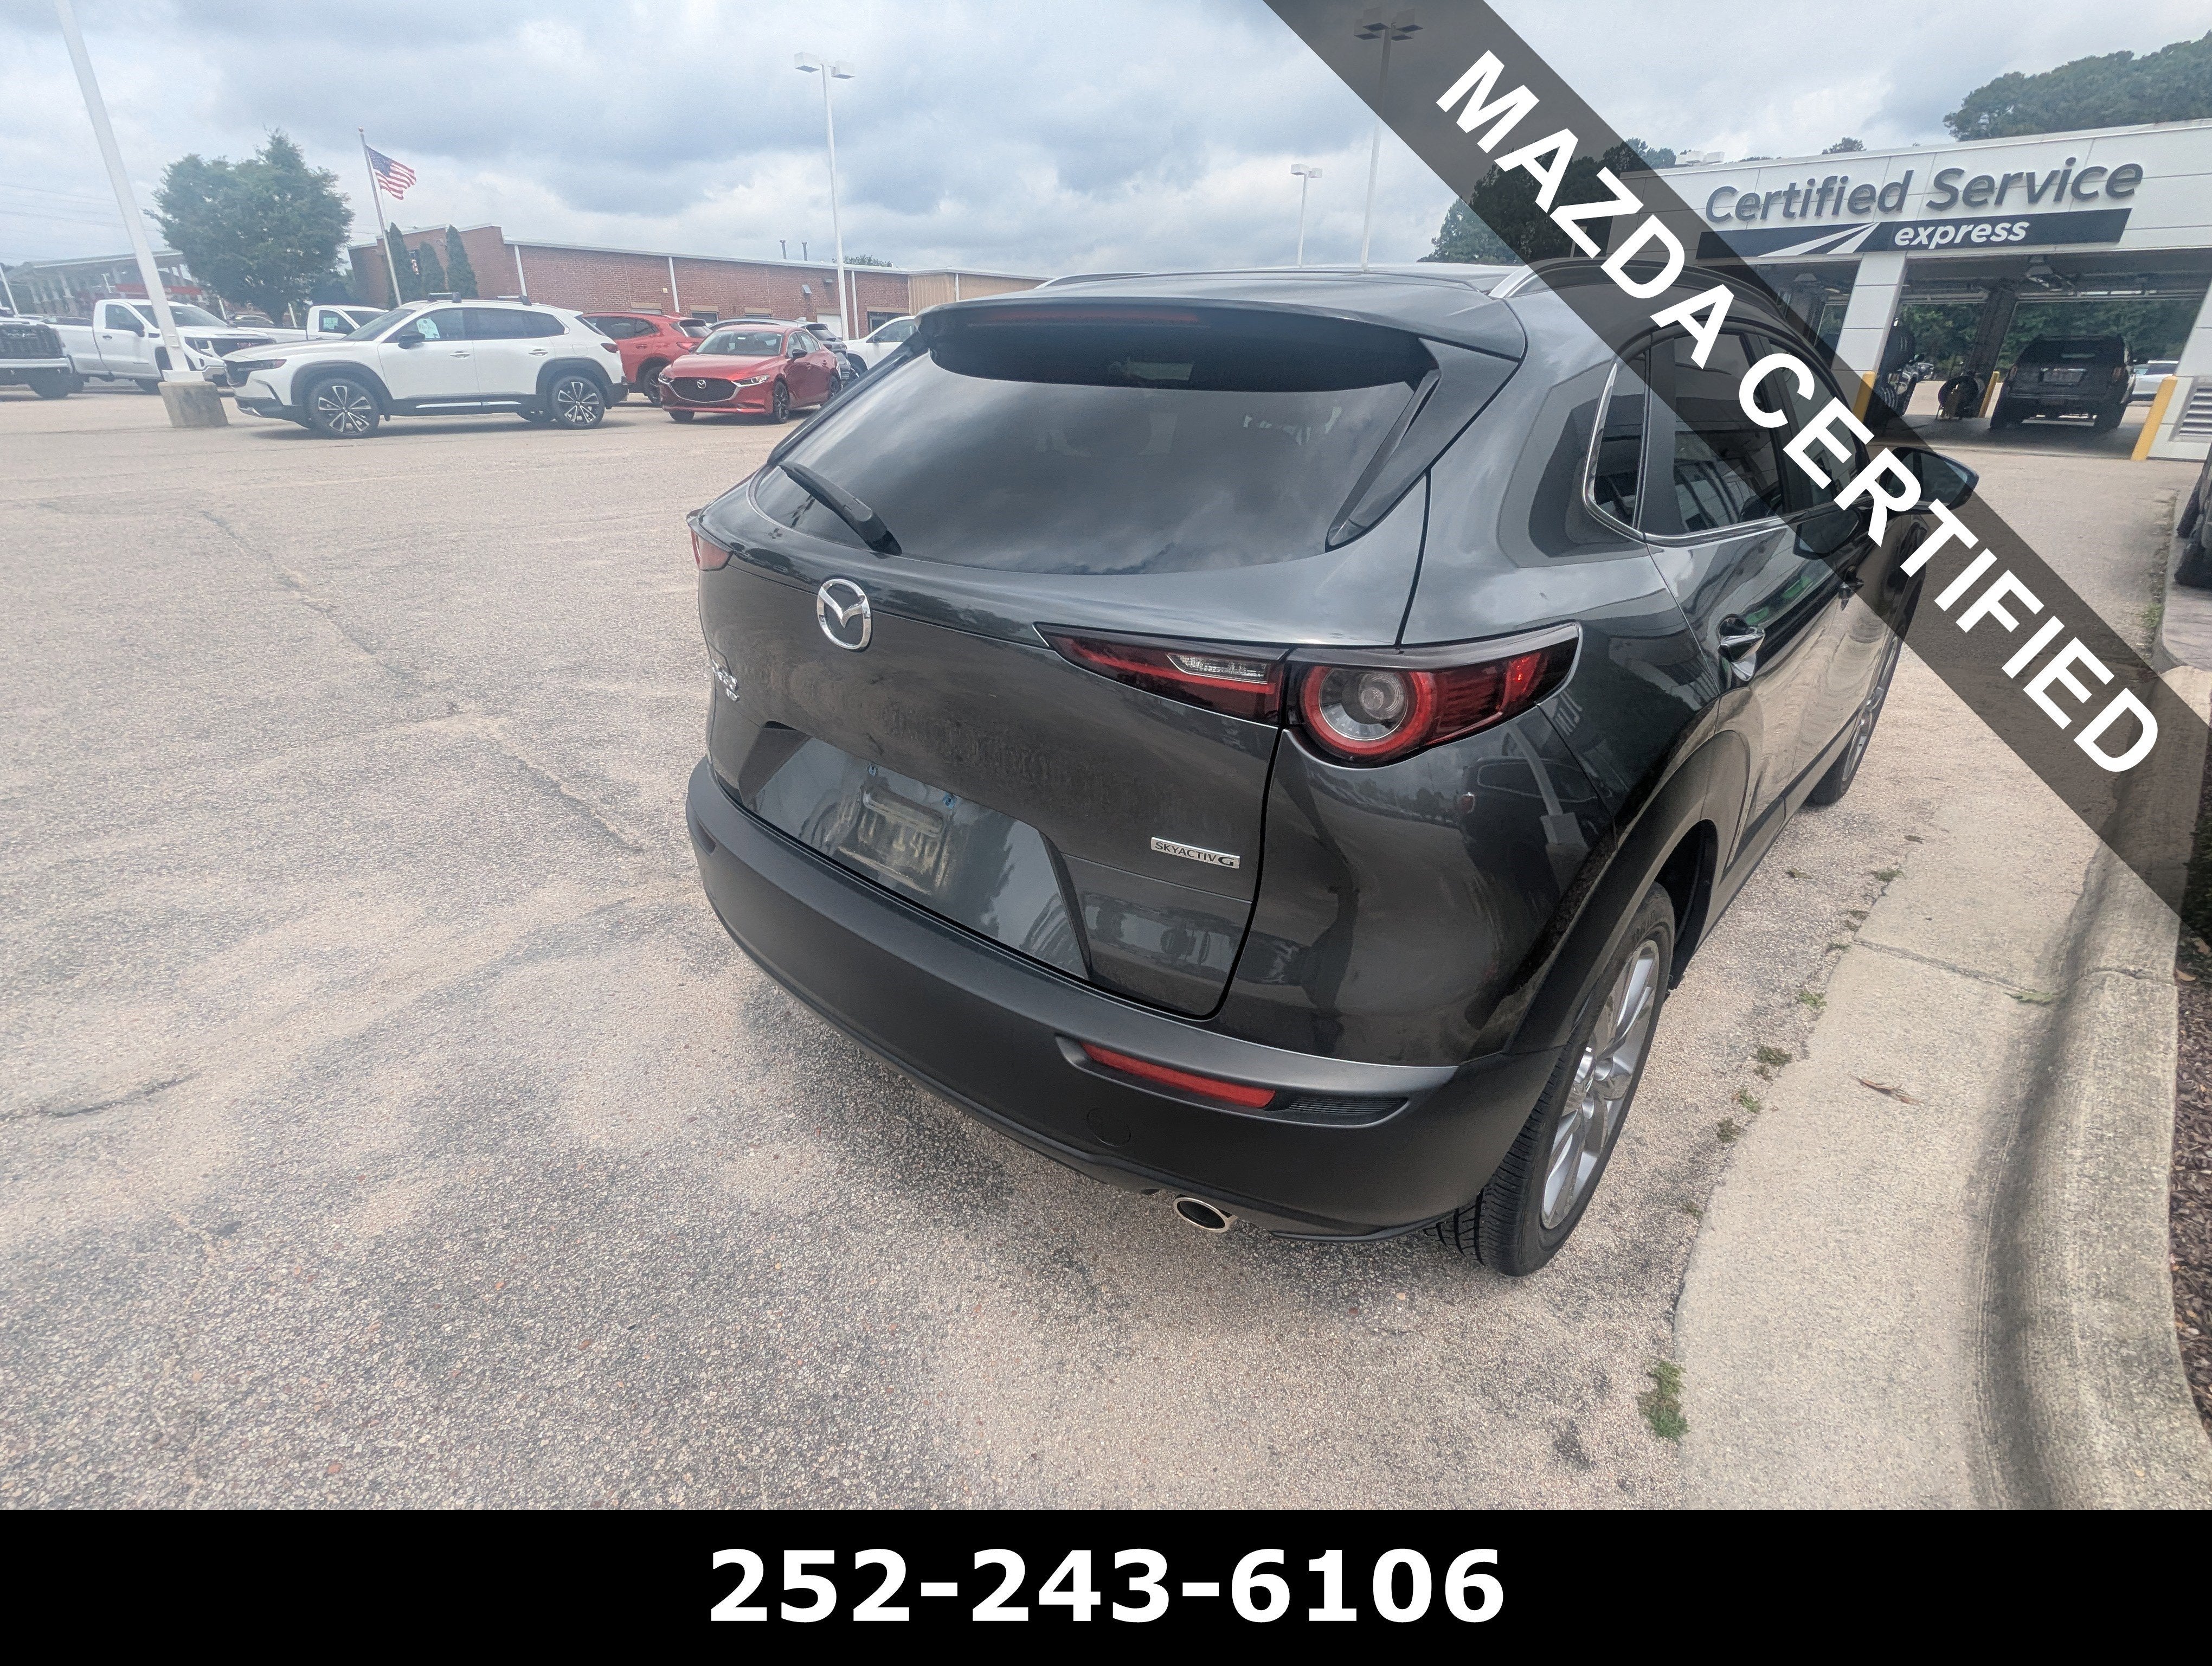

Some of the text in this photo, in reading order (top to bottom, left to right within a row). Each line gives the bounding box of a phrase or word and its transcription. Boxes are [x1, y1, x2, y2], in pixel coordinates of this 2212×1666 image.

[1706, 157, 2143, 223] Certified Service
[1895, 221, 2030, 249] express
